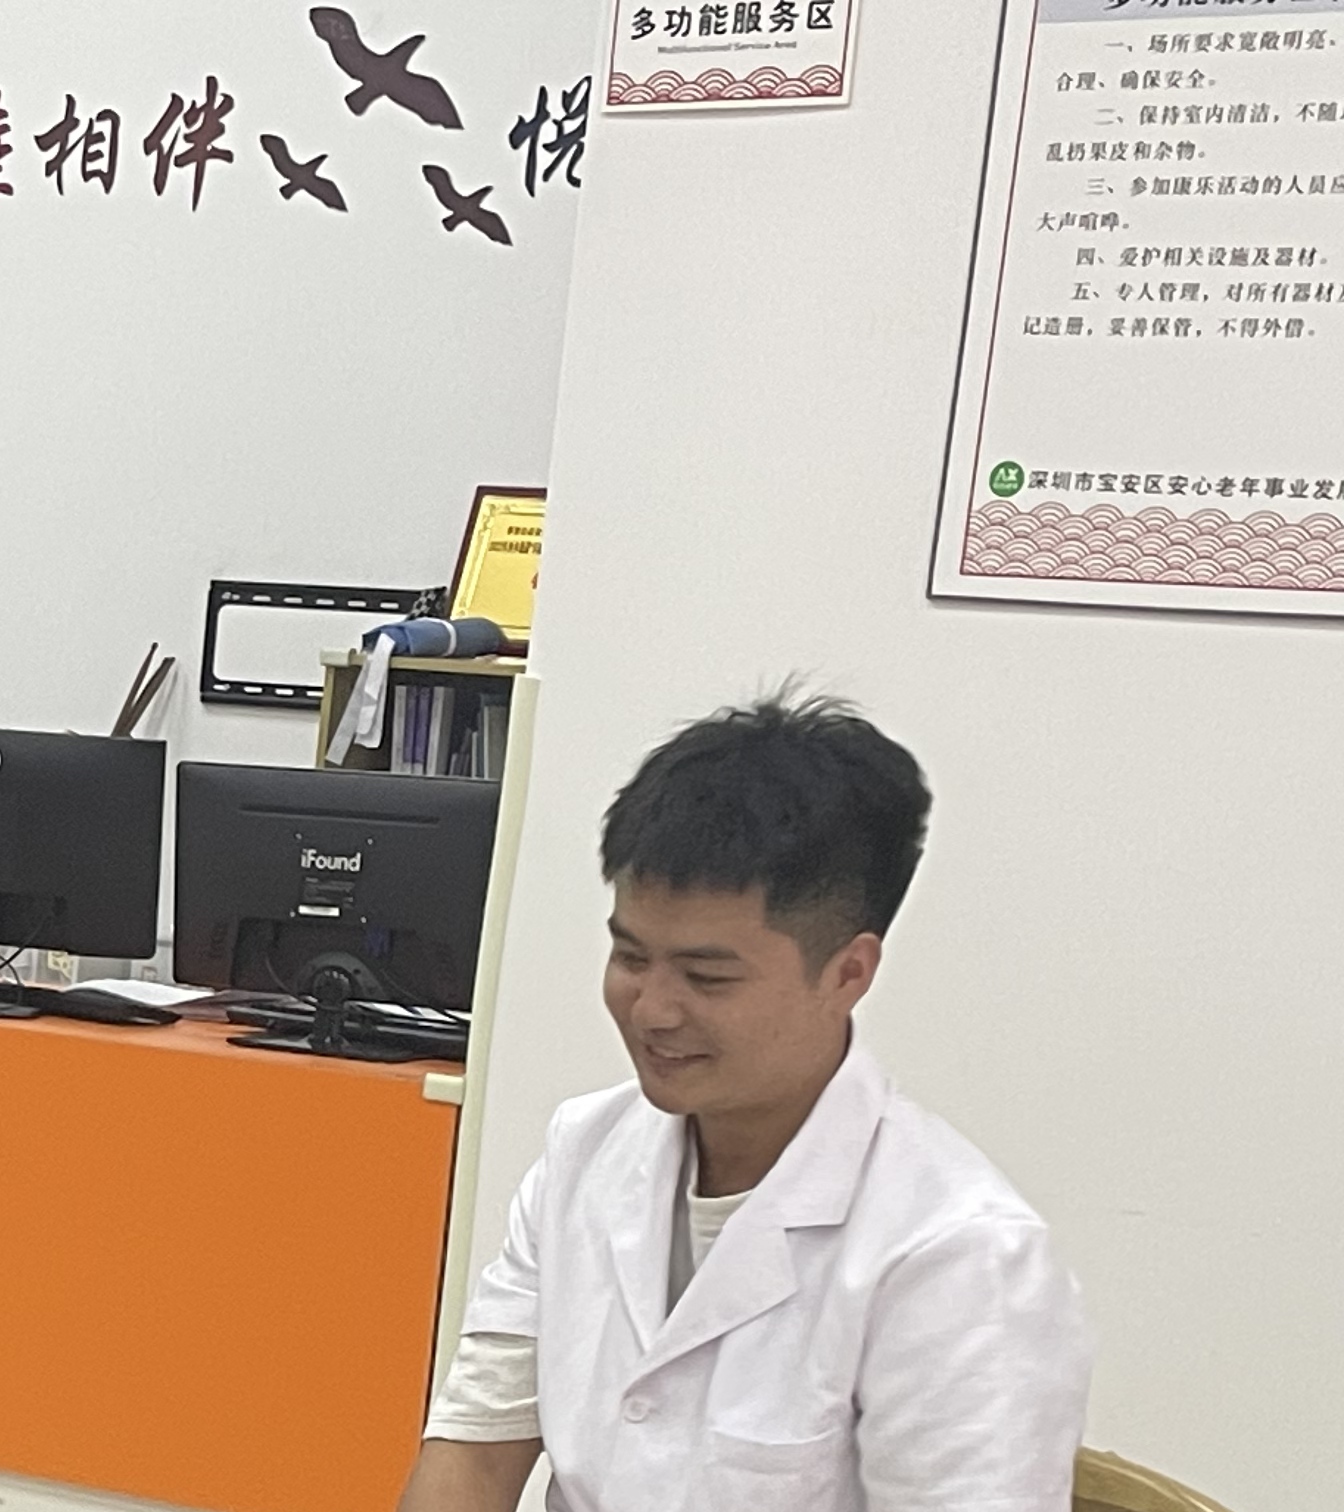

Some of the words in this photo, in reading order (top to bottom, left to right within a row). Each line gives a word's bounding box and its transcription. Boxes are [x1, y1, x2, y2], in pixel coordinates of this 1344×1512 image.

[631, 0, 835, 40] 多功能服务区
[1094, 101, 1344, 125] 二、保持室内清洁，不随
[301, 848, 361, 872] iFound
